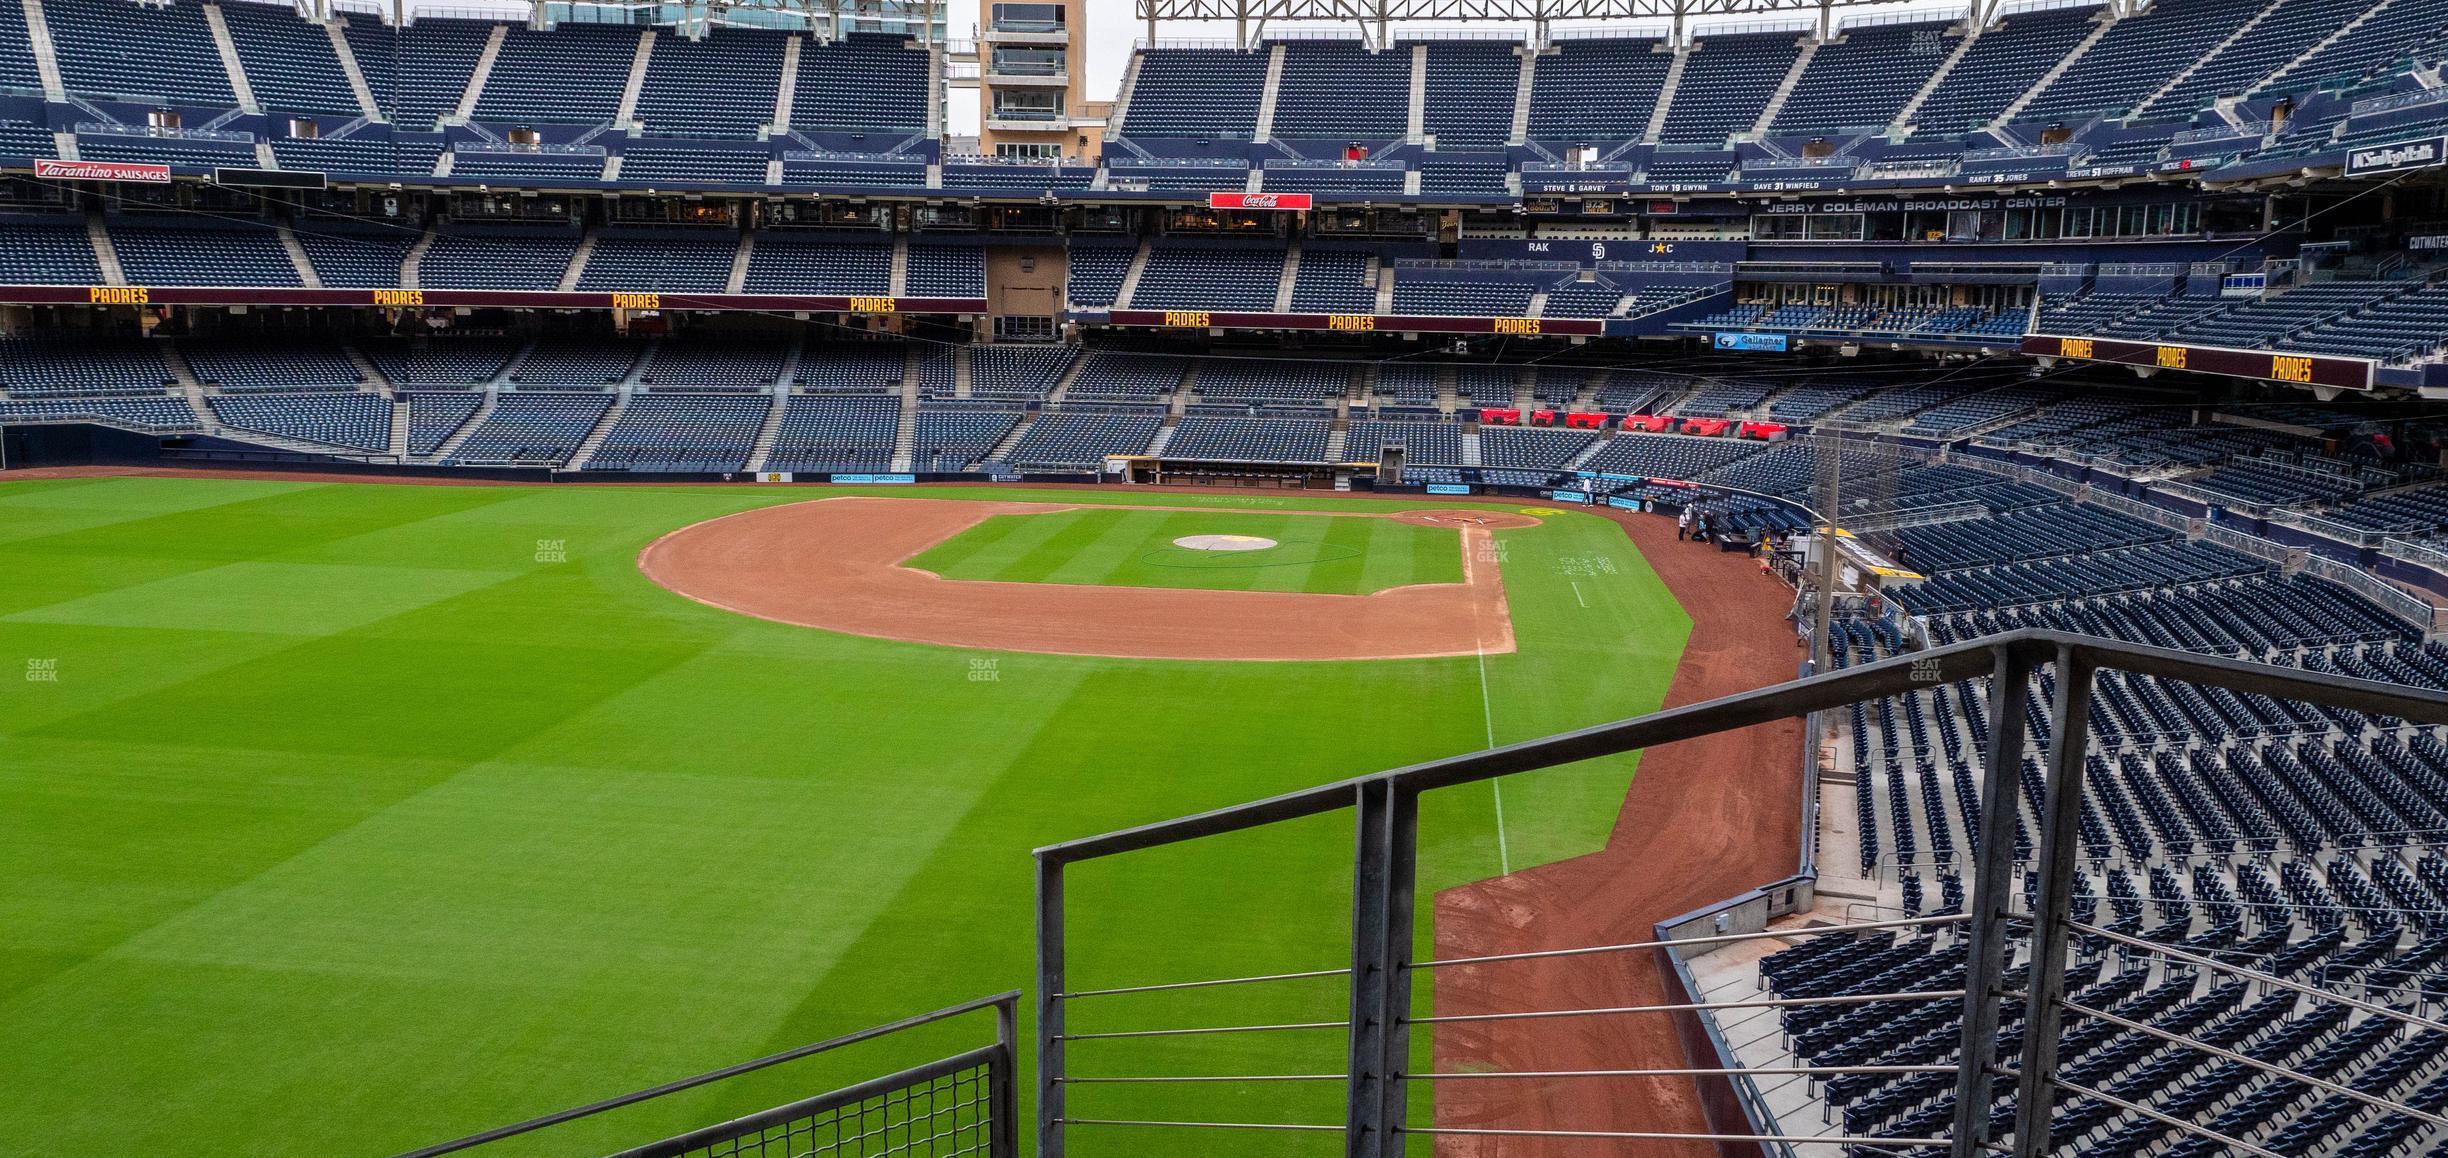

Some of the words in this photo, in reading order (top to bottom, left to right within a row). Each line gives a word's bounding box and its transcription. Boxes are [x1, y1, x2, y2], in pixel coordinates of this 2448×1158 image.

[40, 161, 112, 178] Tarantino
[114, 169, 168, 180] SAUSAGES
[1968, 175, 1992, 183] RANDY
[1993, 174, 2004, 183] 35
[2005, 173, 2028, 181] JONES
[2065, 169, 2091, 178] TREVOR
[2091, 167, 2101, 177] 51
[2102, 166, 2134, 175] HOFFMAN
[1568, 184, 1575, 192] 6
[1774, 182, 1784, 190] 31
[1767, 203, 1816, 213] JERRY
[1823, 201, 1898, 212] COLEMAN
[1904, 200, 2000, 211] BROADCAST
[2005, 196, 2066, 208] CENTER
[1528, 242, 1549, 252] RAK
[2409, 235, 2448, 250] CUTWATER
[90, 287, 148, 303] PADRES
[374, 289, 423, 305] PADRES
[613, 293, 660, 309] PADRES
[850, 297, 895, 312] PADRES
[1165, 312, 1210, 327] PADRES
[1329, 315, 1374, 330] PADRES
[1494, 318, 1540, 334] PADRES
[2060, 338, 2093, 358] PADRES
[2157, 346, 2186, 369] PADRES
[2271, 356, 2312, 382] PADRES
[832, 474, 851, 482] petco
[874, 474, 893, 482] petco
[1609, 496, 1625, 505] petco
